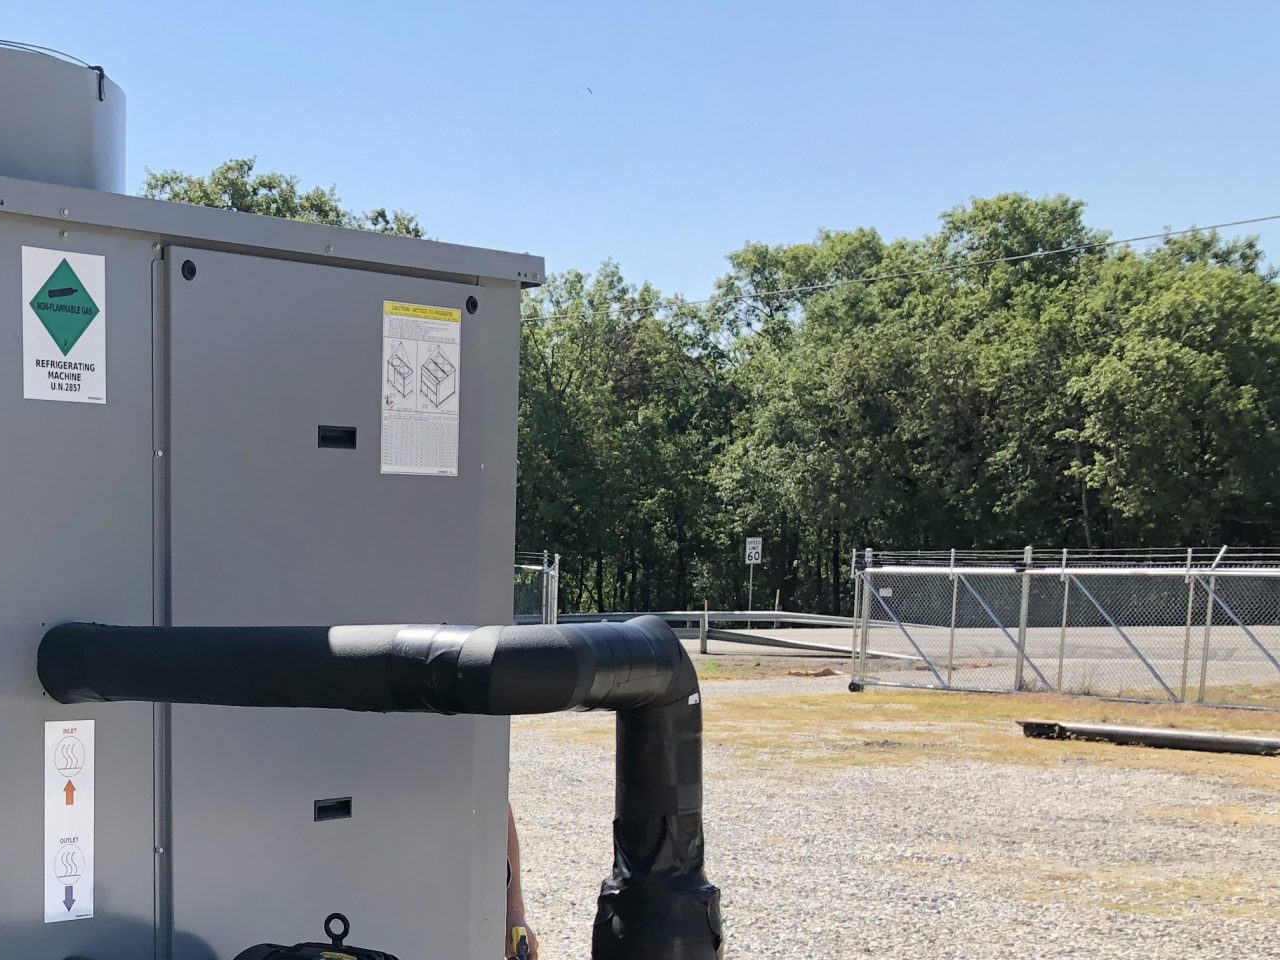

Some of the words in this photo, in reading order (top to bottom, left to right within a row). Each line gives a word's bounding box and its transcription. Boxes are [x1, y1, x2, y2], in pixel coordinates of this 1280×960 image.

[37, 300, 80, 314] NON-FLAMMABLE
[82, 306, 92, 315] GAS
[36, 359, 95, 372] REFRIGERATING
[48, 371, 81, 381] MACHINE
[51, 382, 80, 392] U.N.2857
[748, 551, 760, 561] 60
